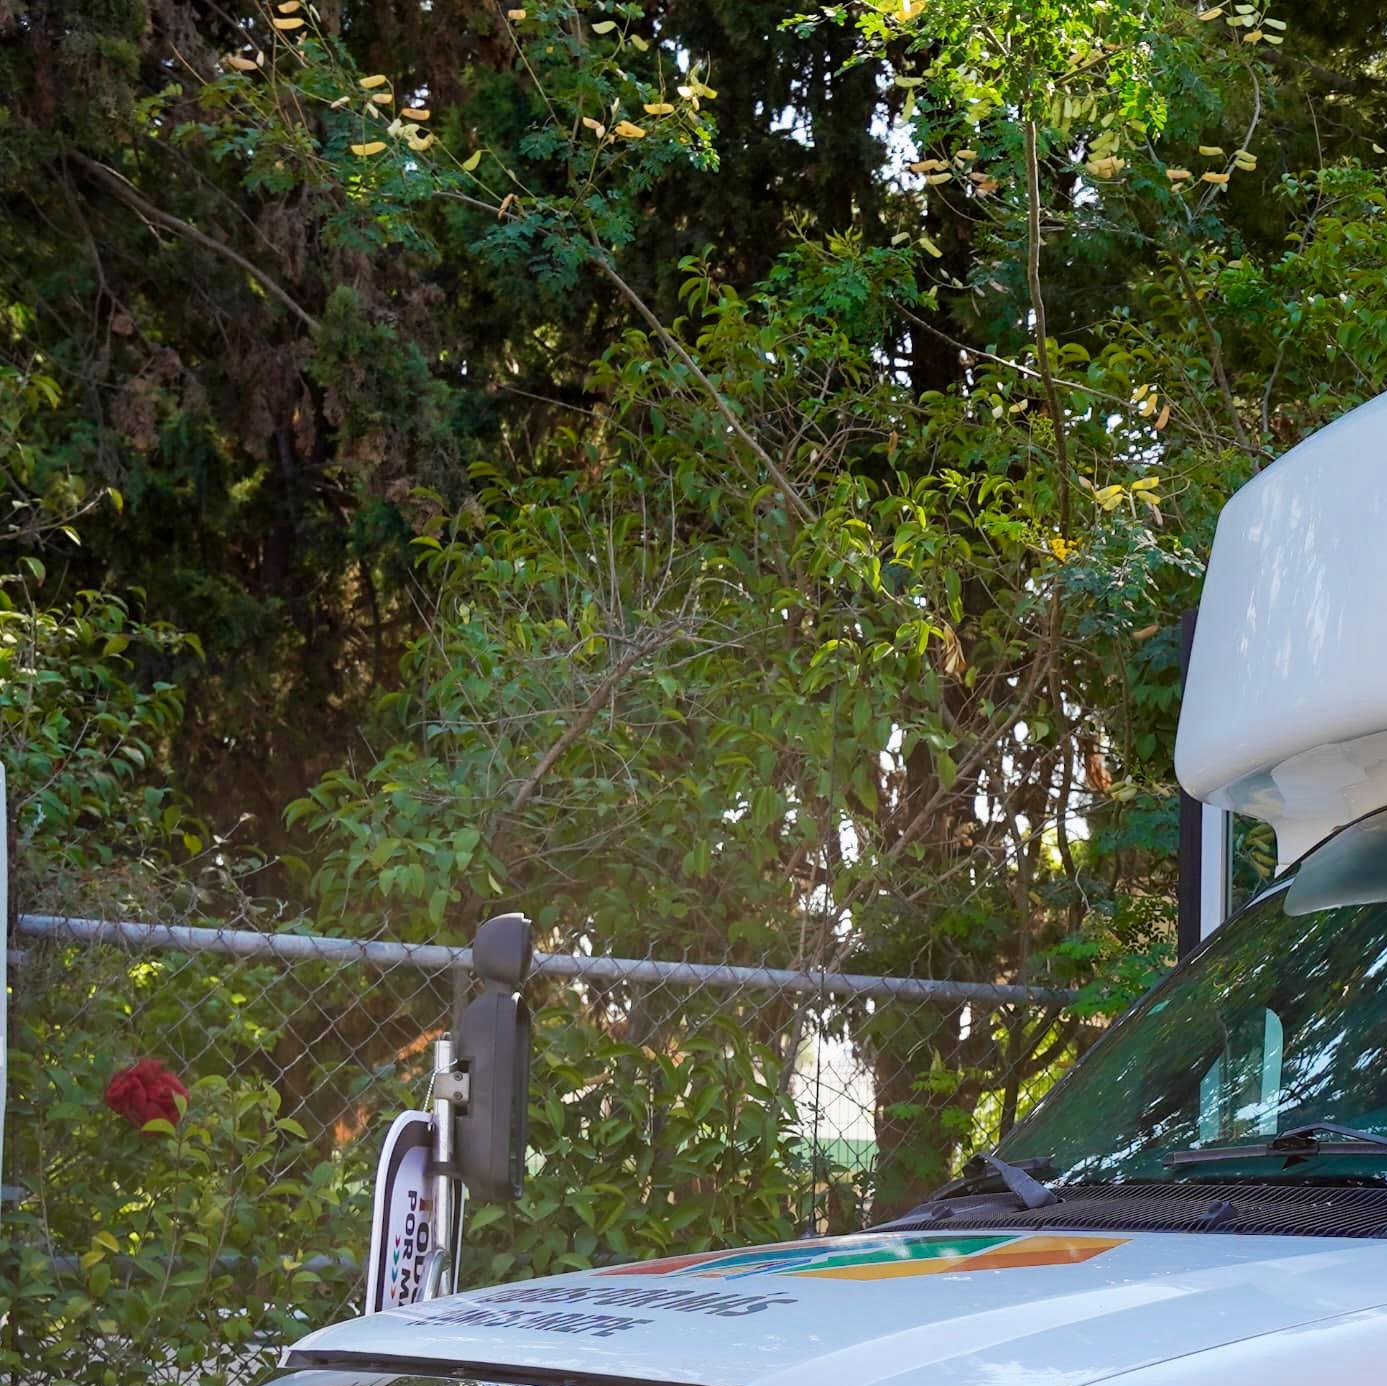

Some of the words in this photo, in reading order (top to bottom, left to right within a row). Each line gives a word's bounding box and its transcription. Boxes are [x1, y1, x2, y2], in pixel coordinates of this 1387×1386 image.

[402, 1190, 418, 1260] POR
[646, 1291, 799, 1317] MÁS
[503, 1311, 657, 1337] ARIZPE
